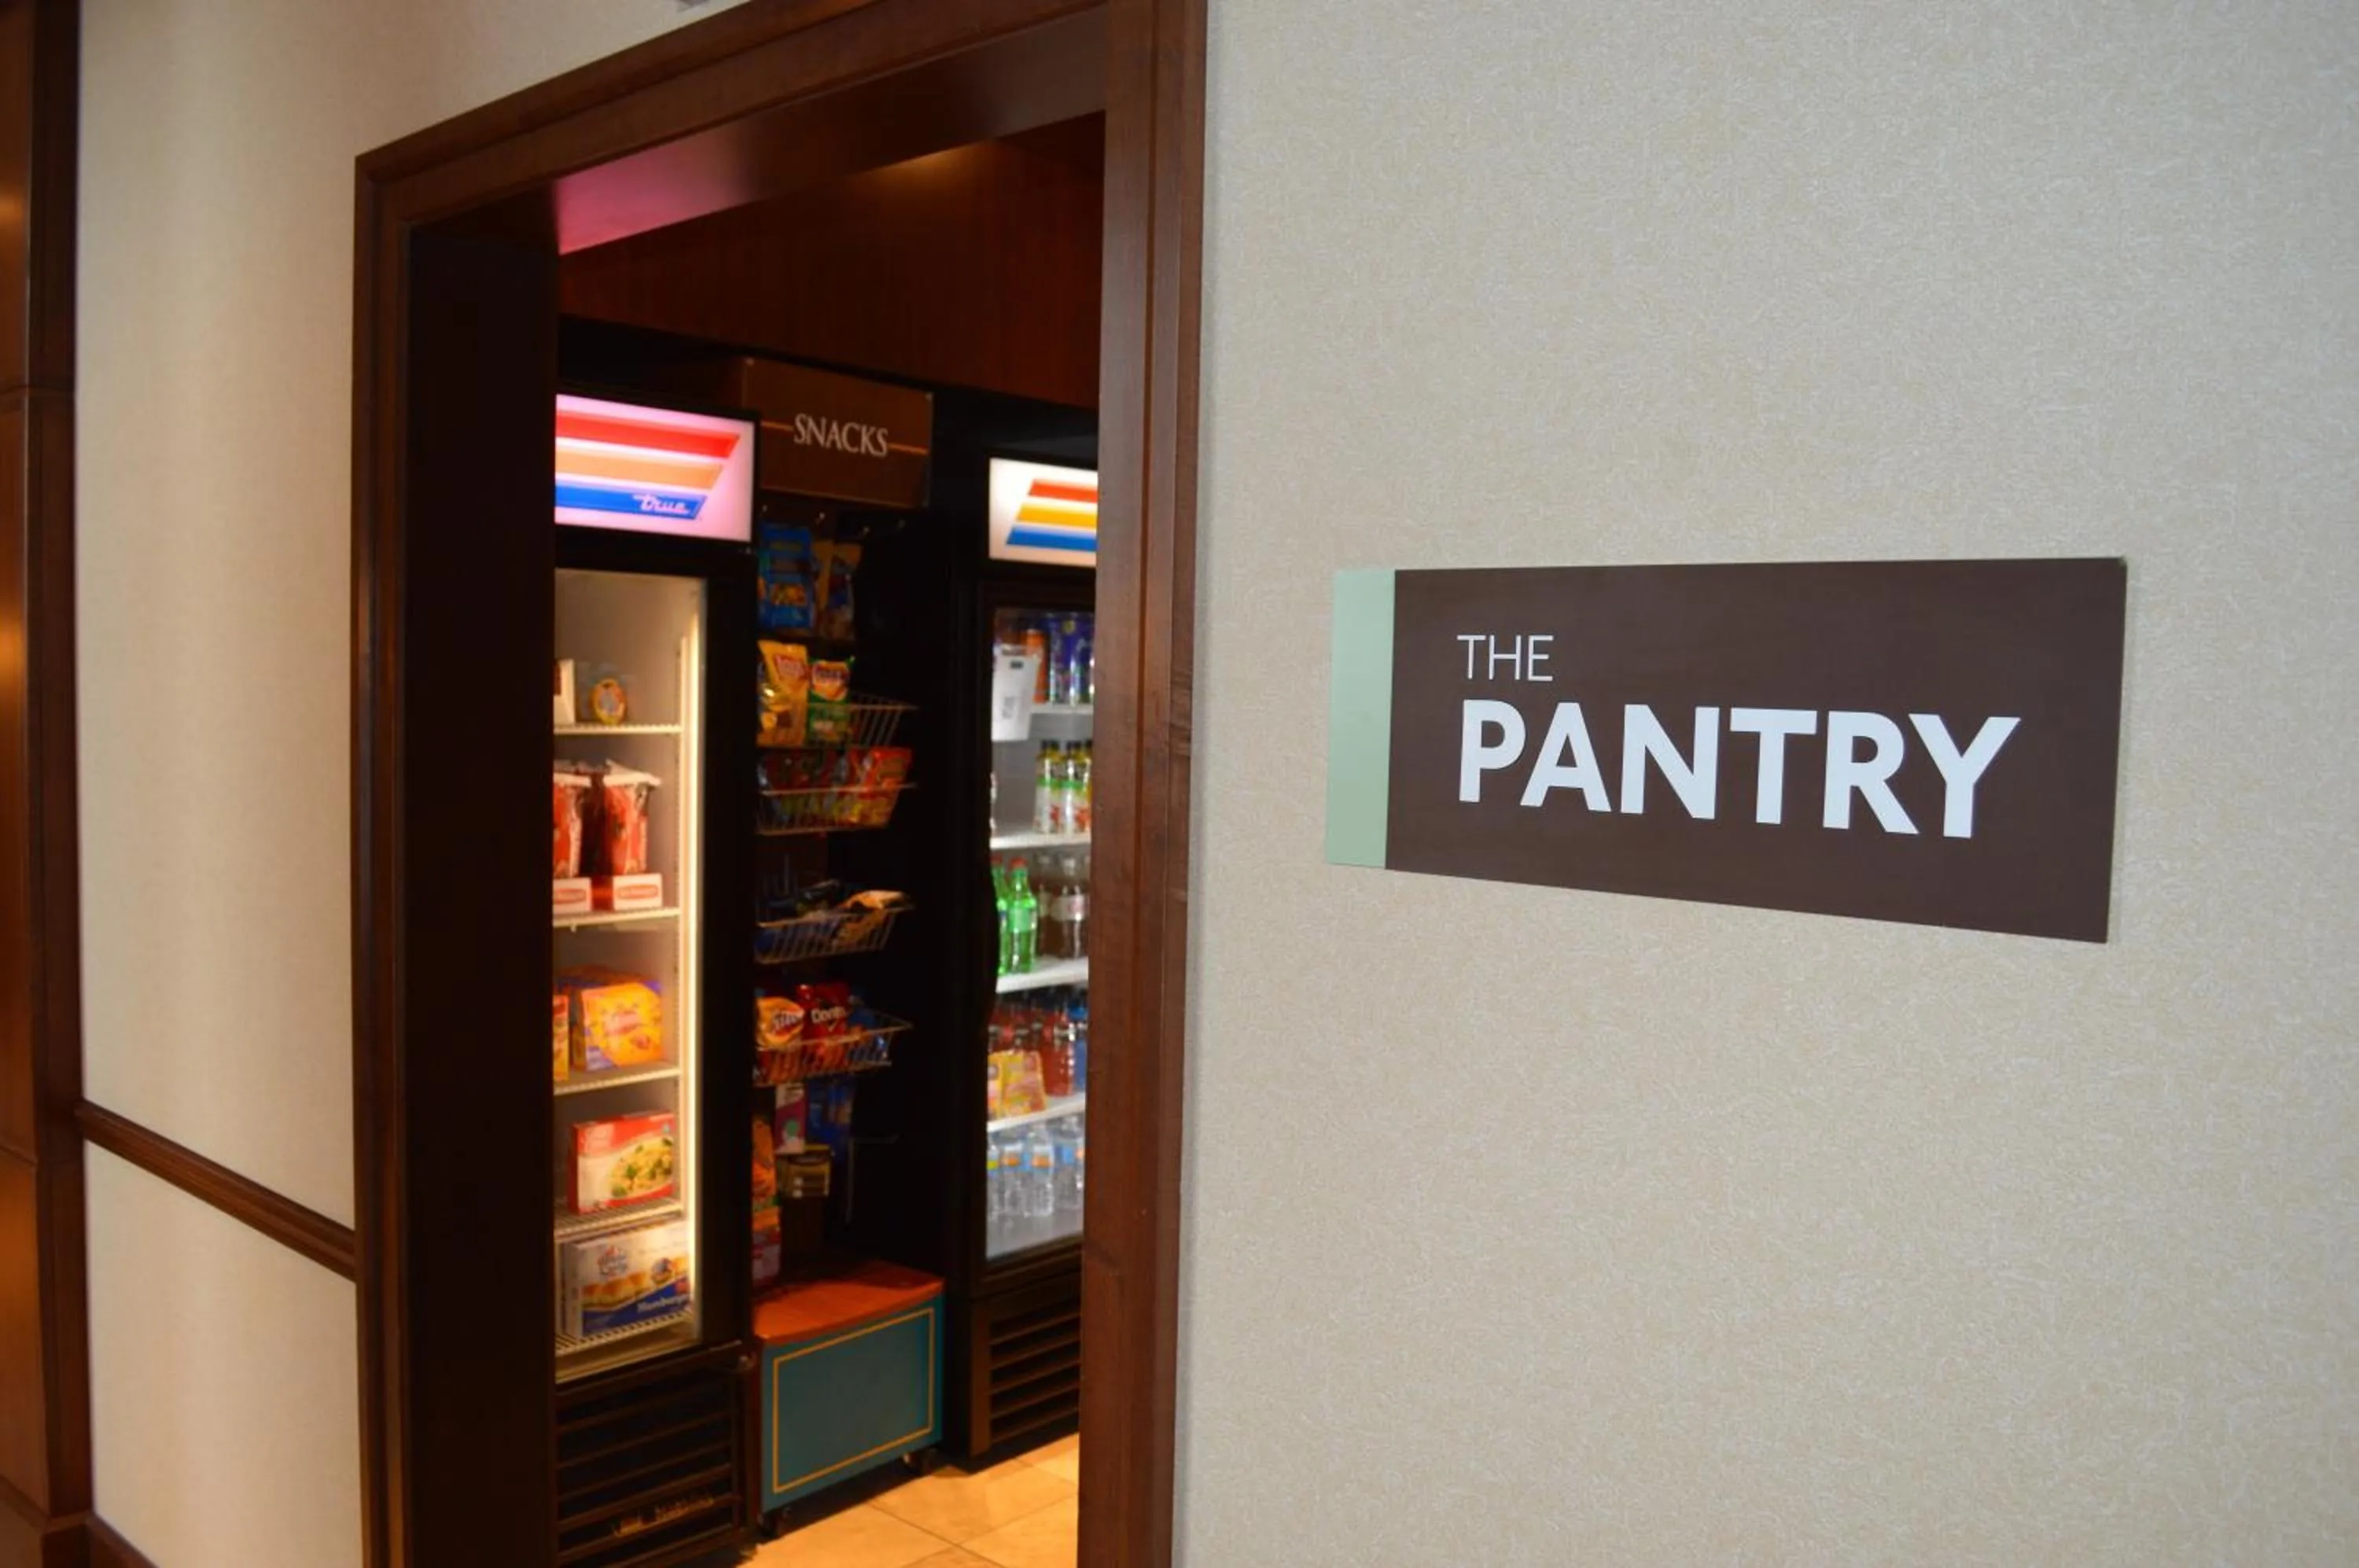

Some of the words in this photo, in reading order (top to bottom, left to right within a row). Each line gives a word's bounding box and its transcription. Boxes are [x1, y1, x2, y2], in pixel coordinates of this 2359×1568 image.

[793, 413, 889, 458] SNACKS
[1456, 635, 1554, 682] THE
[1459, 699, 2021, 839] PANTRY
